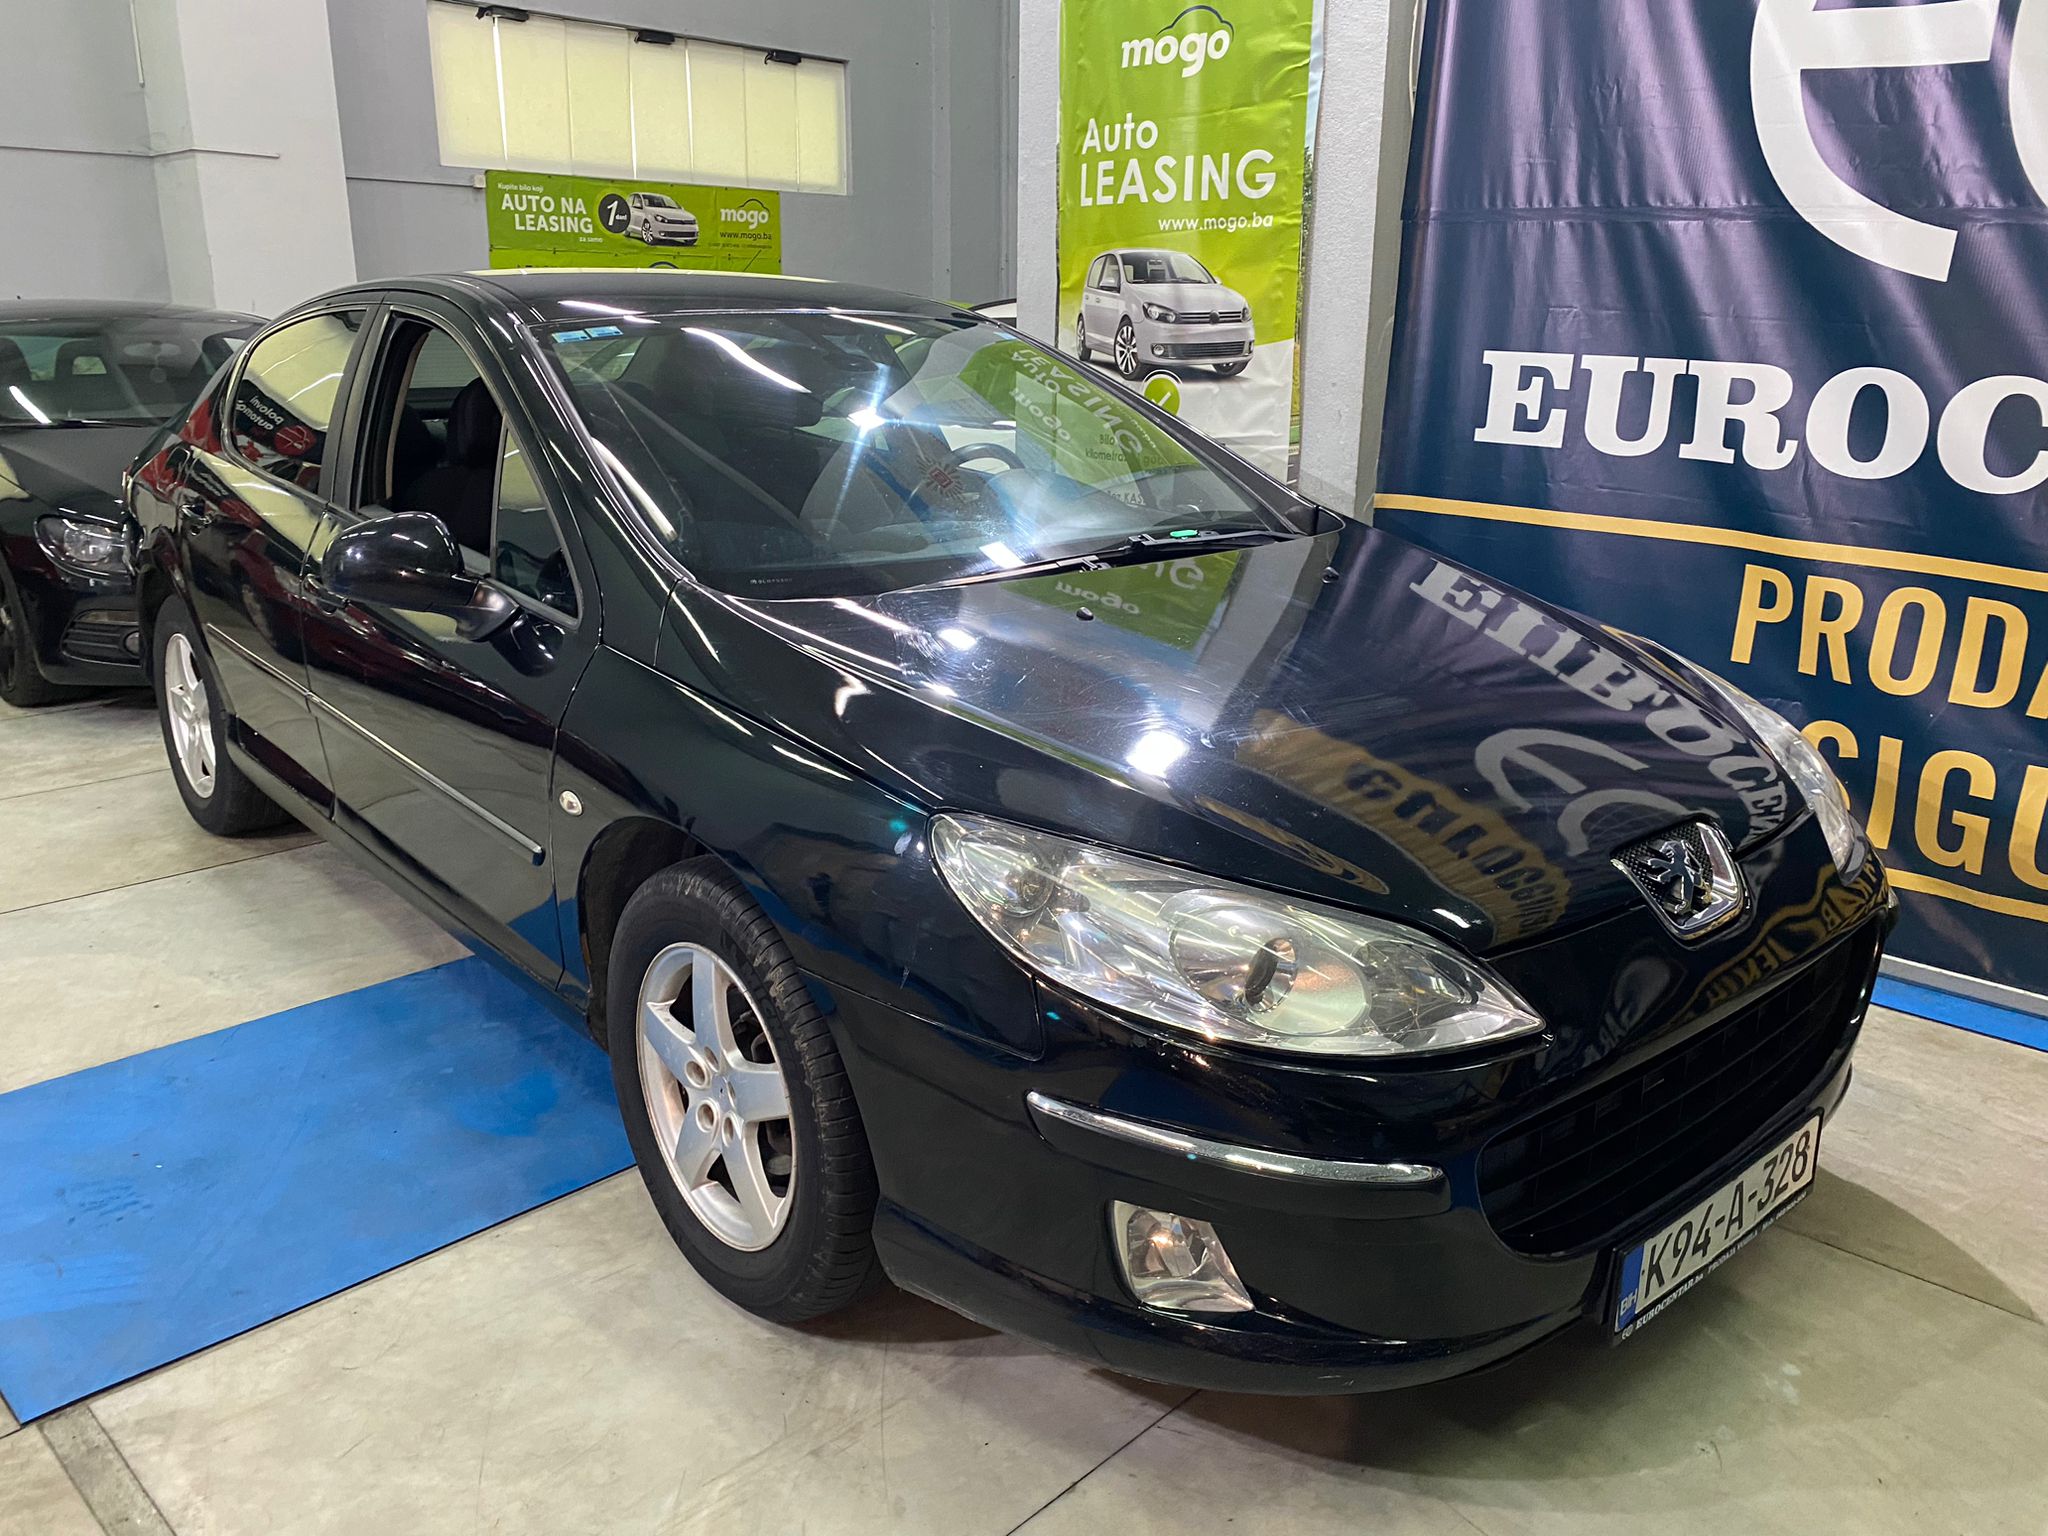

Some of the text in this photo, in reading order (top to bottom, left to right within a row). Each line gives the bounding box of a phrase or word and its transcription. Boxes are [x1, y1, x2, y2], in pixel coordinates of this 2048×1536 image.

[1121, 29, 1230, 78] mogo
[1081, 112, 1158, 155] Auto
[497, 183, 544, 194] Kupite bilo koji
[1080, 149, 1276, 207] LEASING
[501, 193, 587, 215] AUTO NA
[514, 213, 594, 234] LEASING
[720, 207, 769, 229] mogo
[1158, 212, 1274, 233] www.mogo.ba
[720, 232, 773, 241] www.mogo.ba
[1474, 350, 2048, 494] EUROC
[1645, 1130, 1811, 1299] K94-A-328
